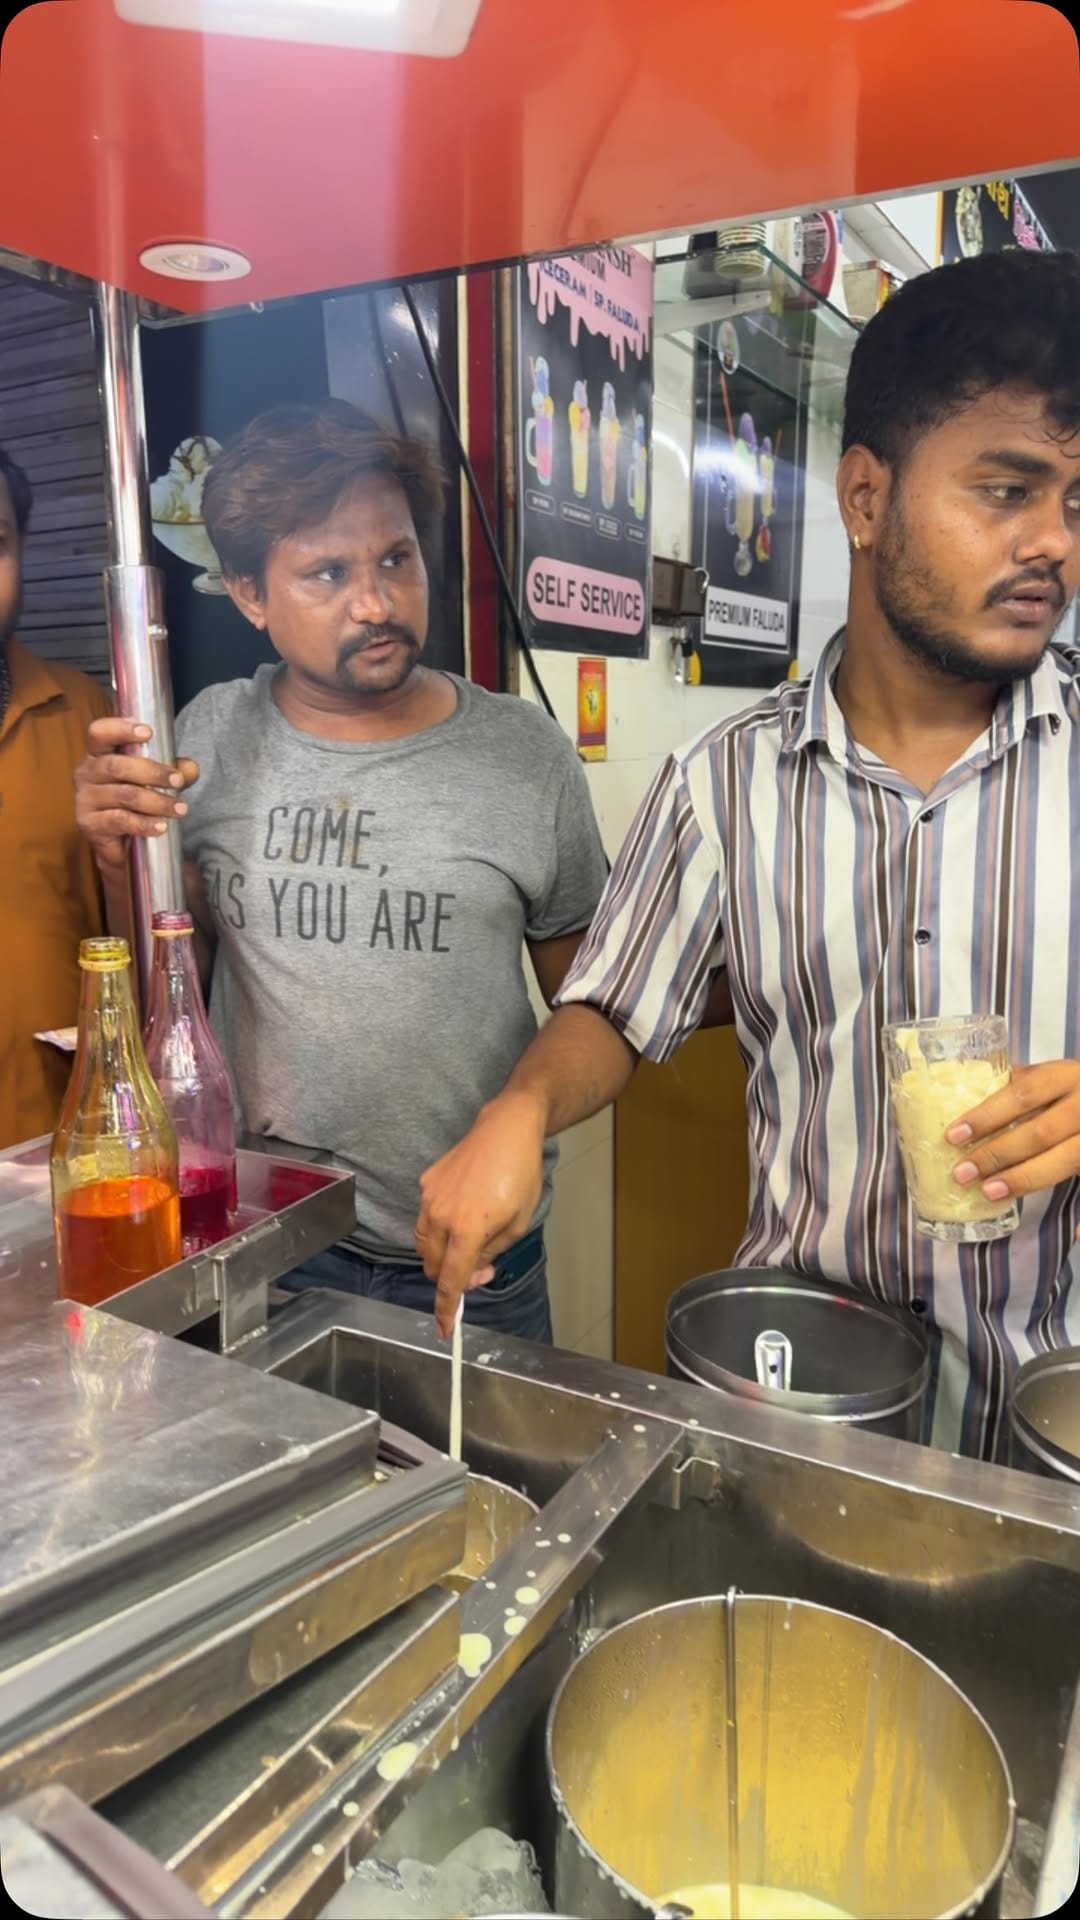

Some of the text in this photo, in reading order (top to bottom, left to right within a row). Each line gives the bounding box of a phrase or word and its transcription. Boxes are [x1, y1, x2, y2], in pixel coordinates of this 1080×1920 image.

[532, 571, 641, 622] SELF SERVICE
[708, 599, 785, 633] PREMIUM FALUDA
[263, 803, 389, 878] COME,
[210, 867, 457, 954] AS YOU ARE
